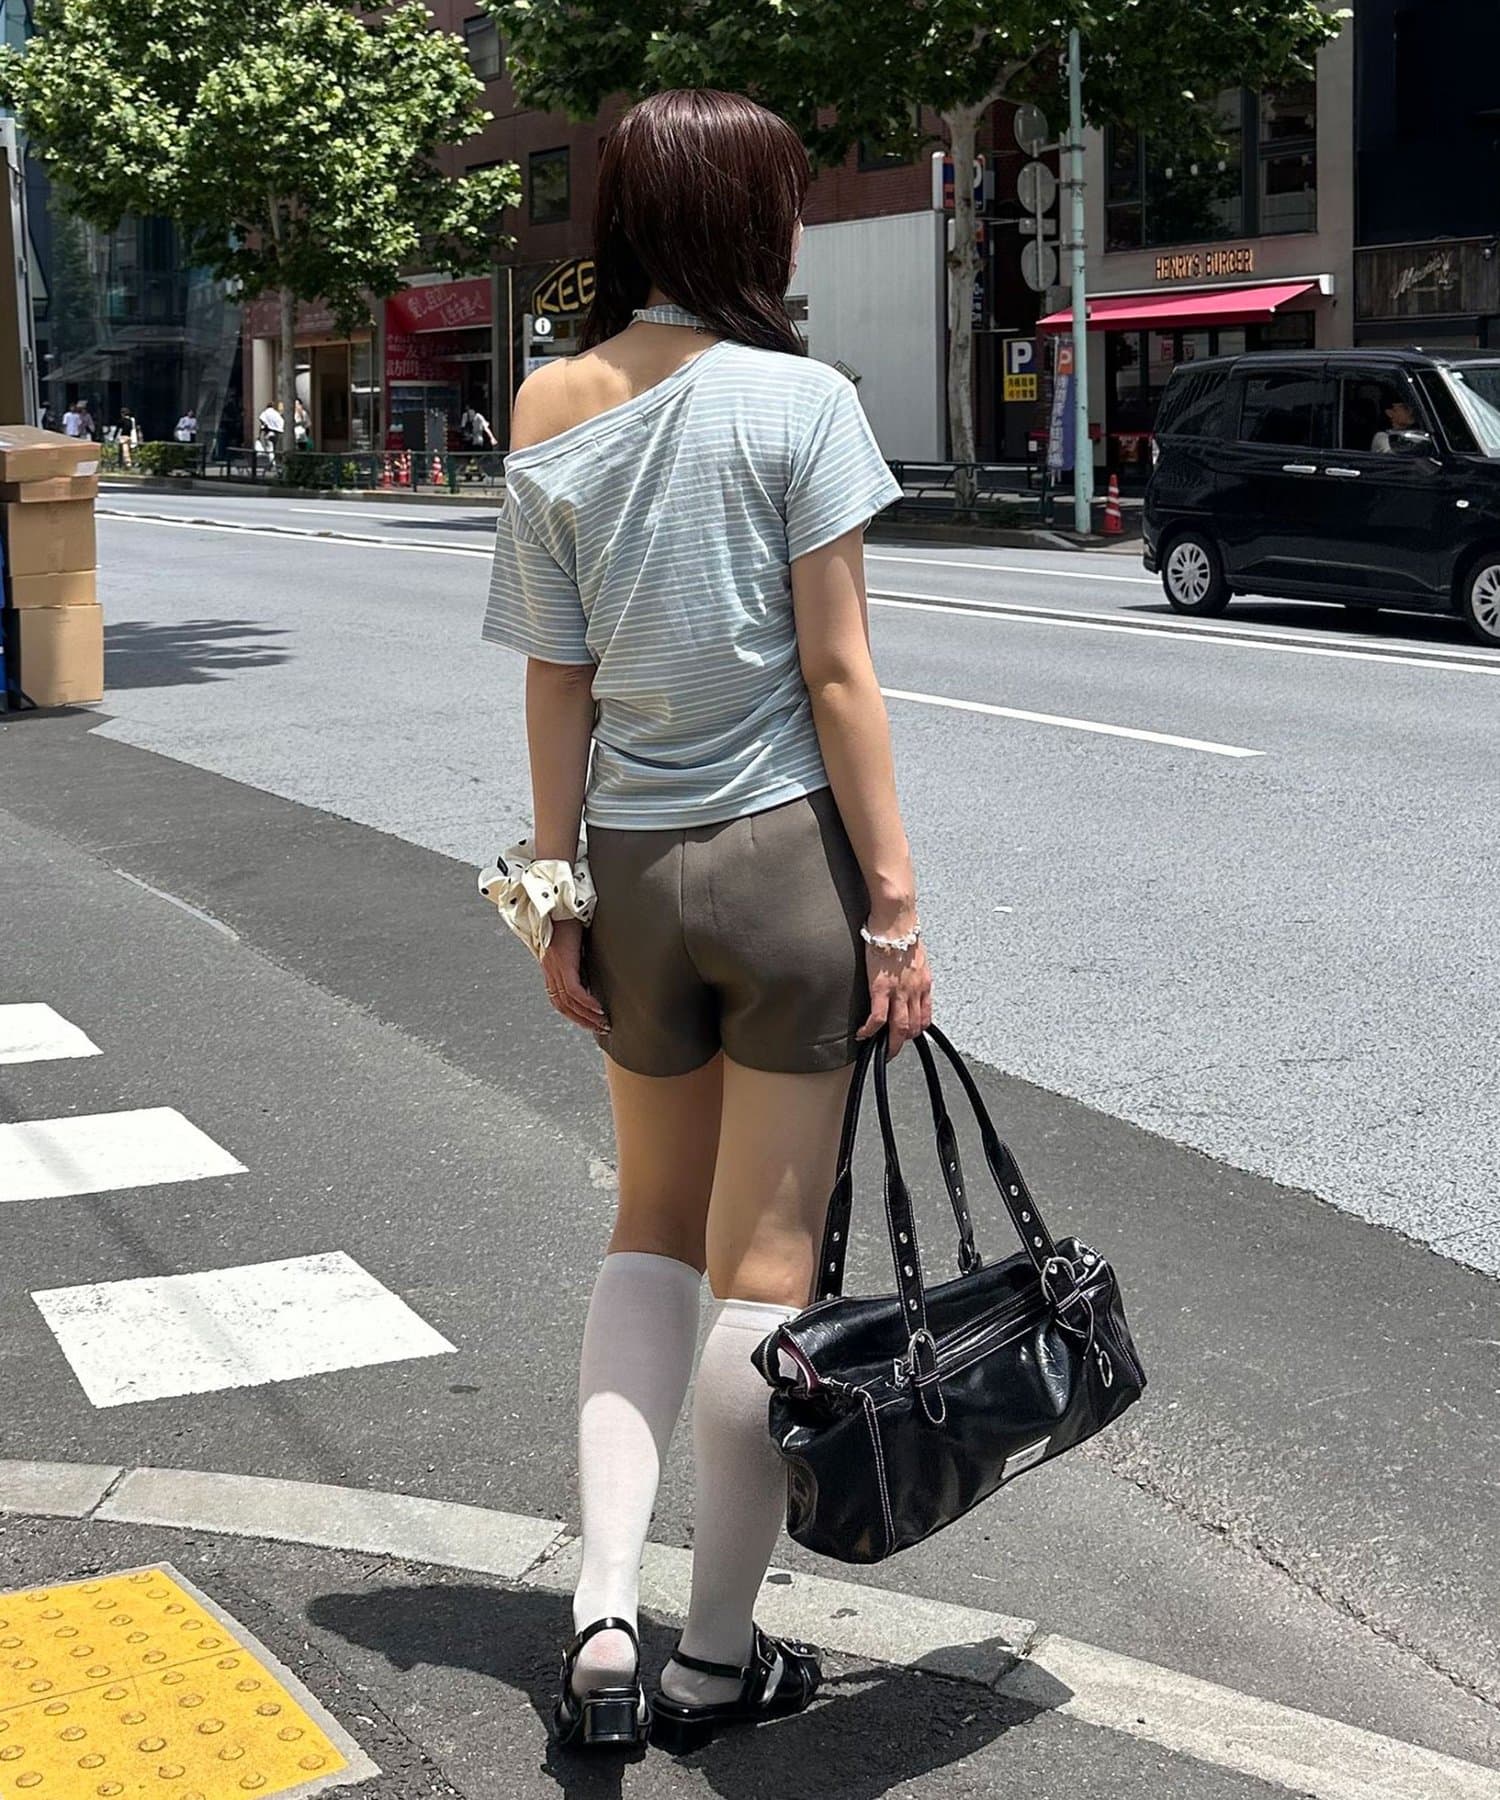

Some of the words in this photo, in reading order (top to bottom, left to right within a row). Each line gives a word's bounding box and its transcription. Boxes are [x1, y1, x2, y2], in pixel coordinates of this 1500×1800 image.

[1155, 254, 1202, 281] HENRY'S
[1205, 248, 1254, 276] BURGER
[1011, 341, 1033, 374] P
[1058, 349, 1072, 371] P
